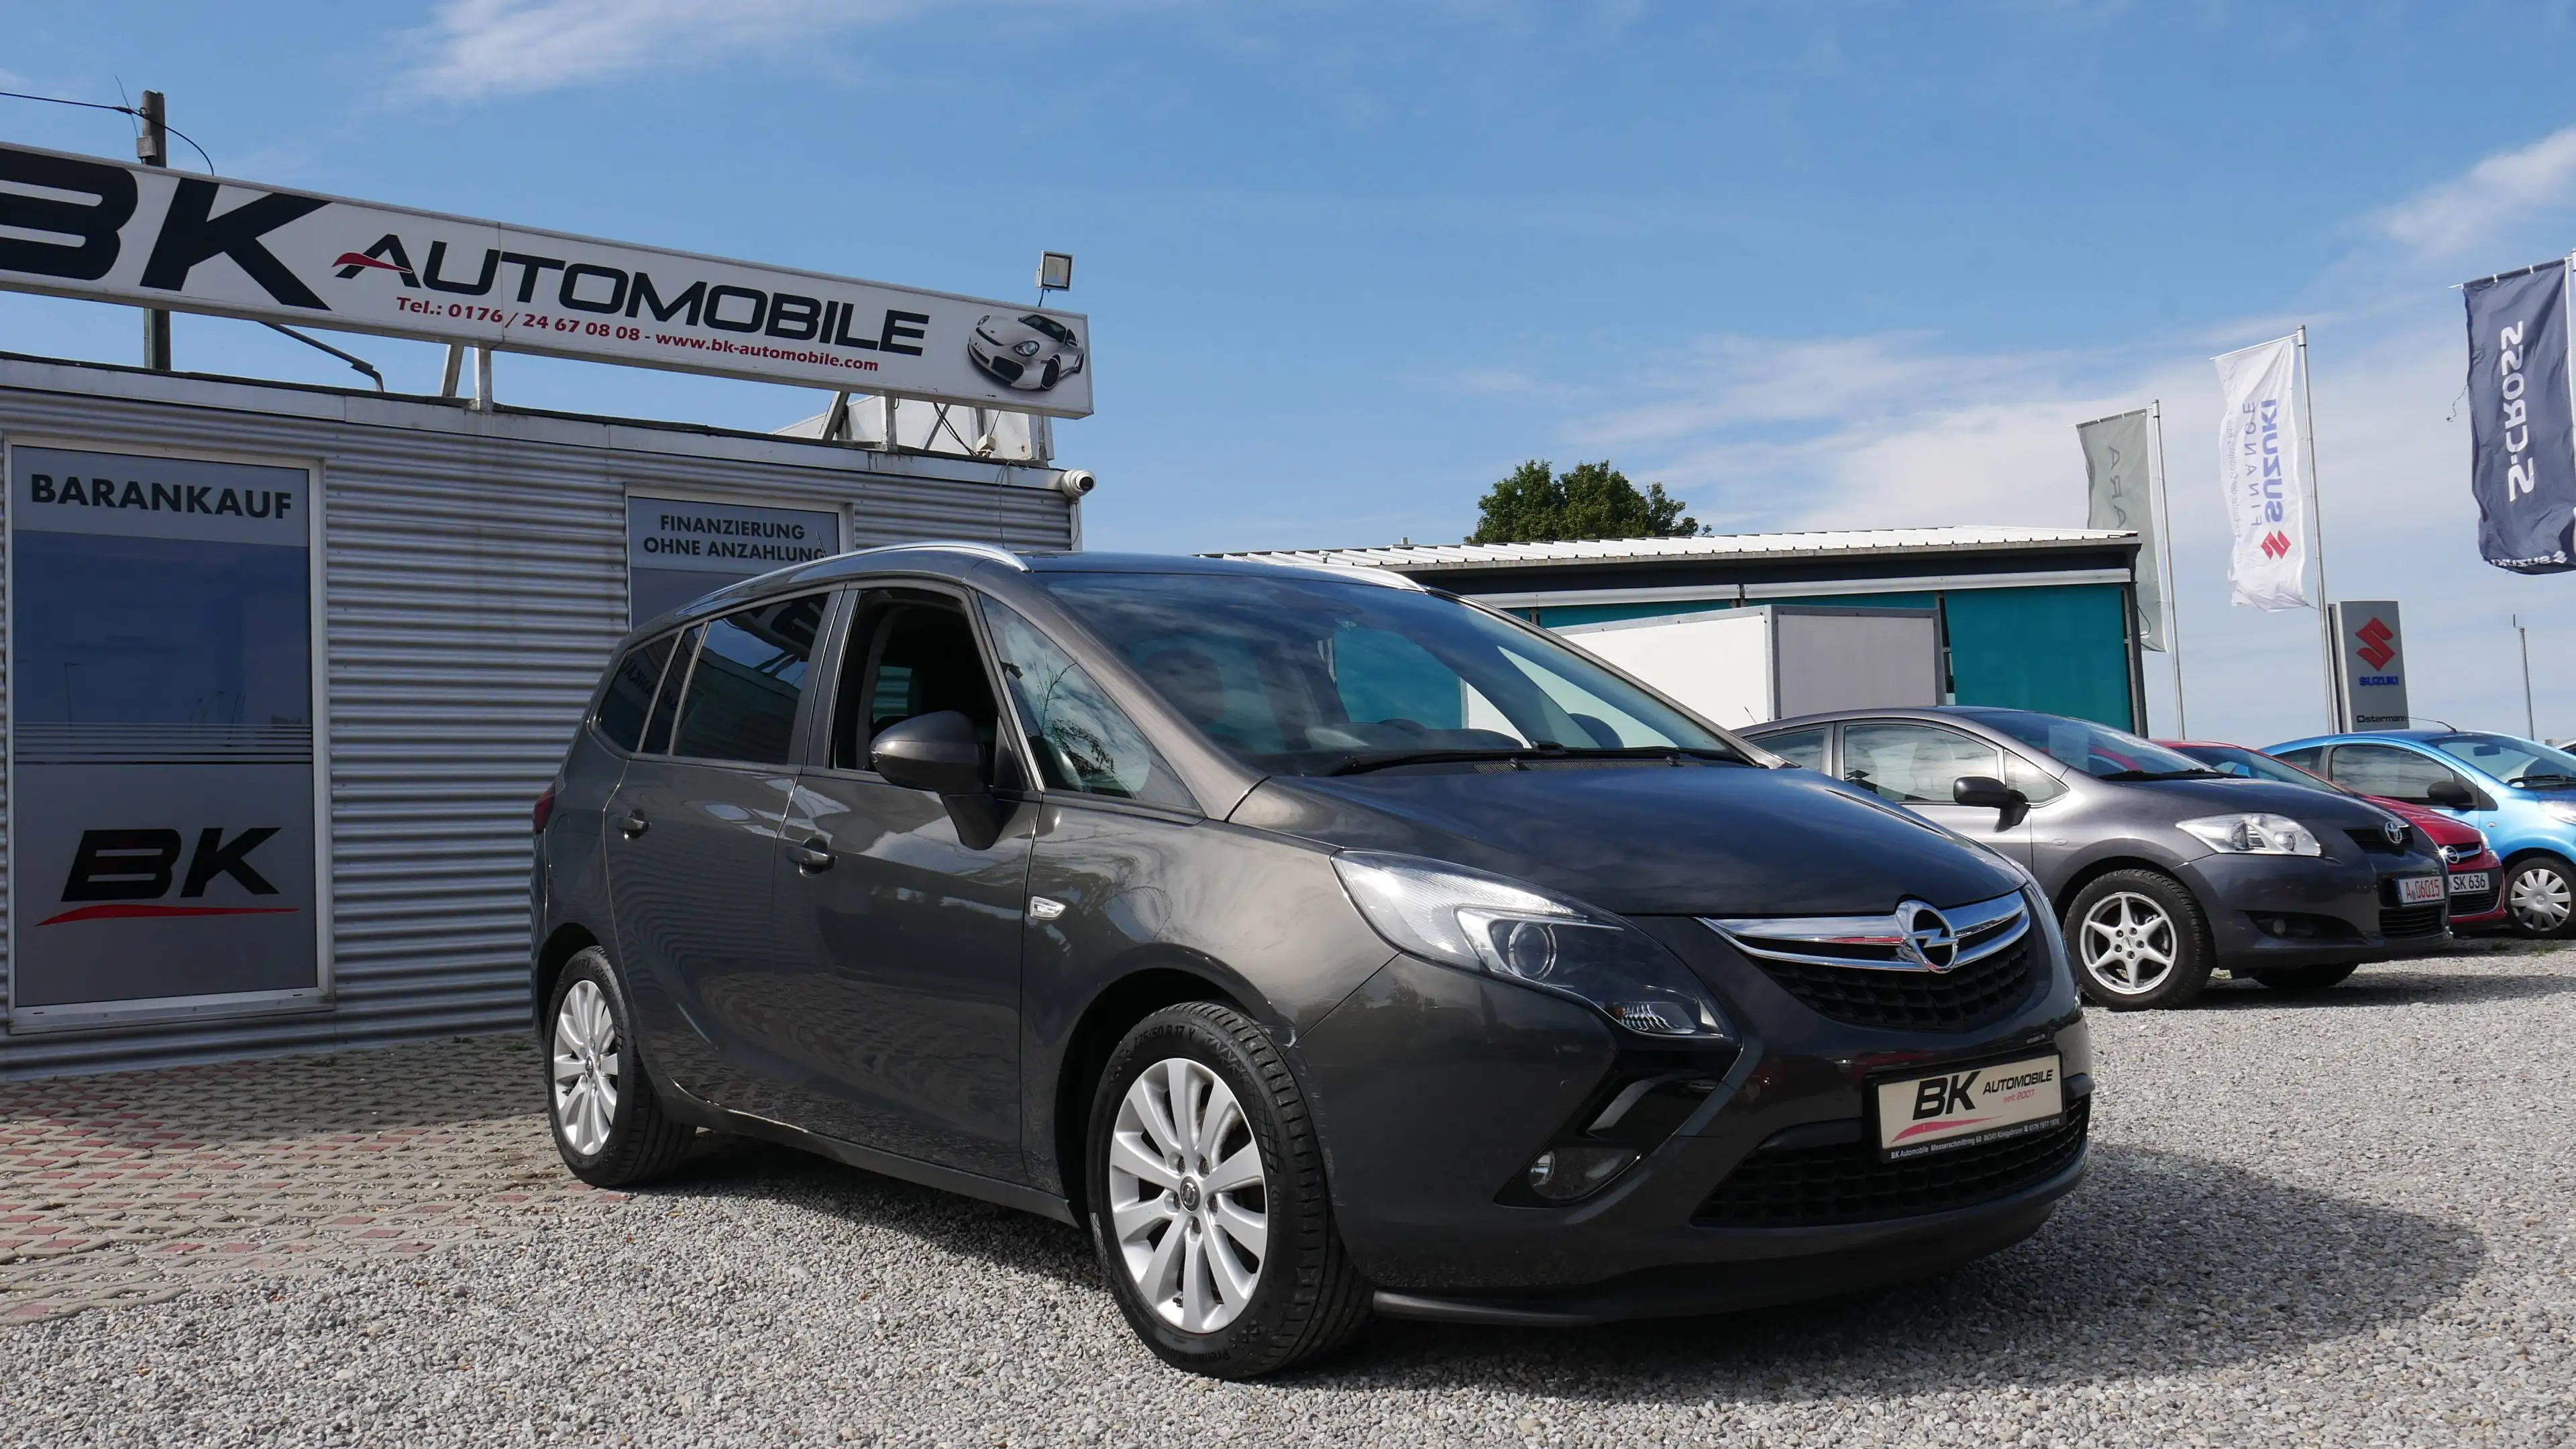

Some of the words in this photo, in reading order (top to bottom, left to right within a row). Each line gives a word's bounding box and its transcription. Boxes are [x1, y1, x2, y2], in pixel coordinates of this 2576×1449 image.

[0, 146, 333, 311] BK
[333, 233, 930, 357] AUTOMOBILE
[396, 297, 442, 315] Tel.:
[448, 303, 503, 323] 0176
[523, 313, 549, 329] 24
[555, 318, 580, 333] 67
[585, 322, 610, 337] 08
[615, 326, 641, 341] 08
[655, 333, 879, 372] www.bk-automobile.com
[30, 474, 292, 520] BARANKAUF
[660, 515, 805, 540] FINANZIERUNG
[643, 537, 700, 556] OHNE
[707, 541, 826, 562] ANZAHLUNG
[2359, 676, 2399, 686] SUZUKI
[2357, 714, 2407, 723] Ostermann
[60, 827, 282, 903] BK
[2406, 881, 2412, 900] A
[2414, 878, 2440, 899] 06015
[2453, 875, 2467, 890] SK
[2469, 875, 2486, 890] 636
[1912, 1070, 1982, 1120] BK
[1982, 1069, 2053, 1095] AUTOMOBILE
[2016, 1089, 2035, 1100] 2007
[1890, 1151, 1900, 1159] BK
[1900, 1146, 1929, 1157] Automobile
